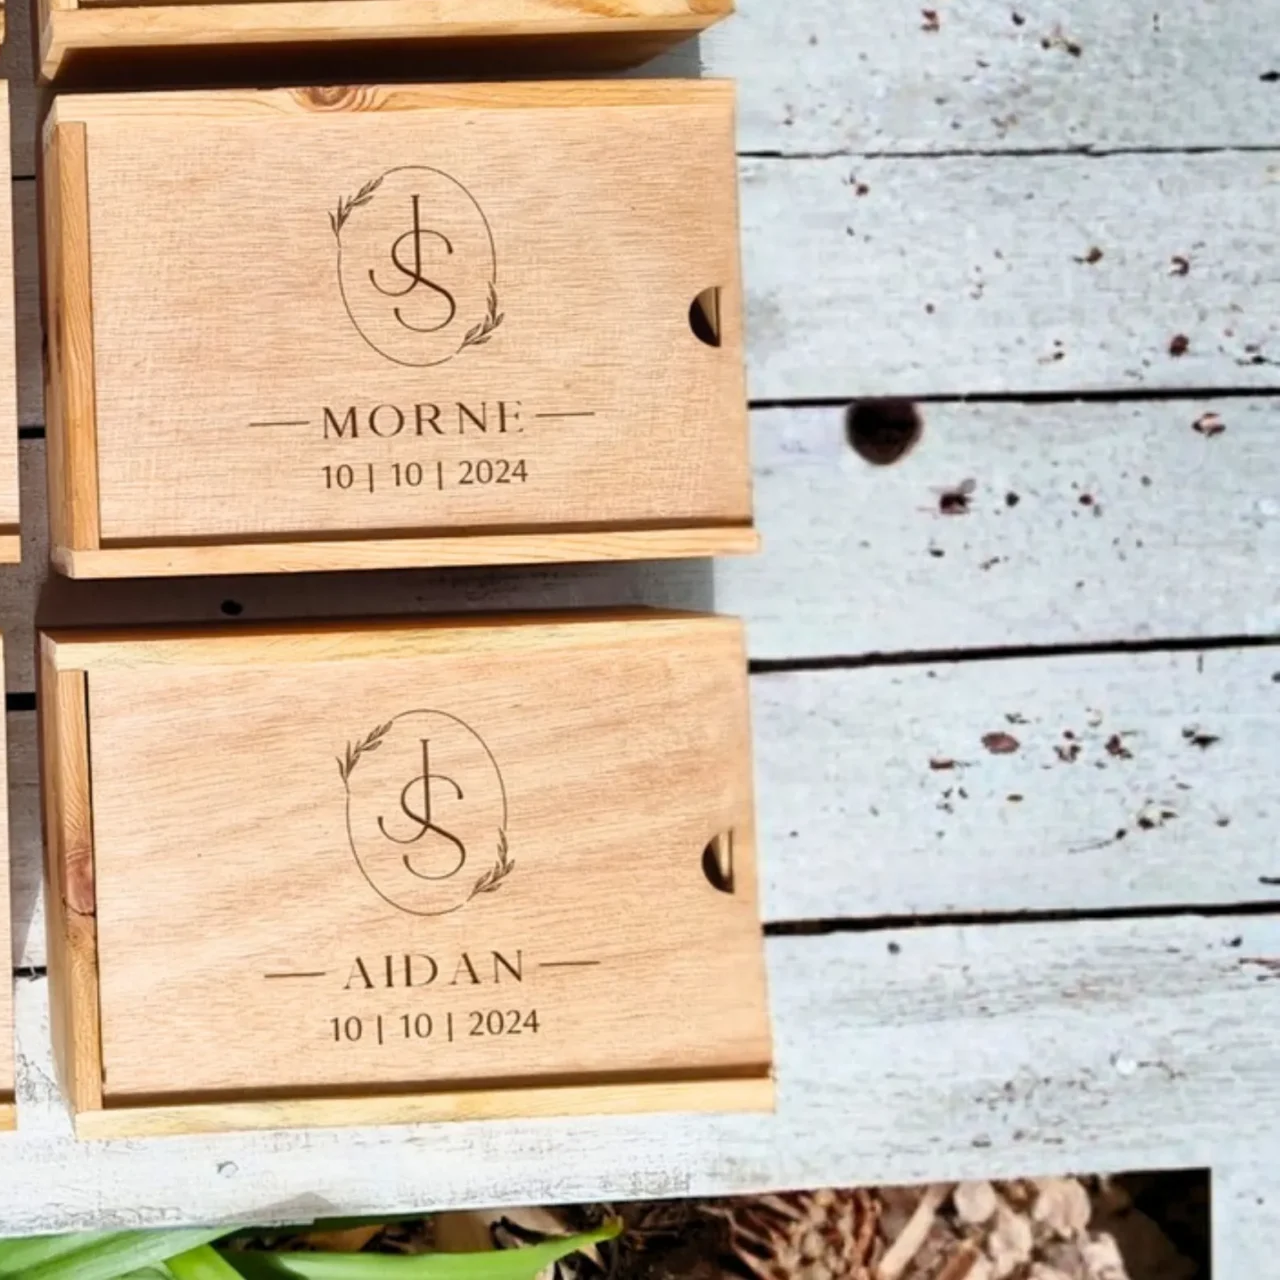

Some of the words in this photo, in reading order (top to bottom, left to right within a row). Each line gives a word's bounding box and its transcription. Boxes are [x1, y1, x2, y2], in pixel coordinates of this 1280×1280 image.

[321, 399, 525, 441] MORNE
[320, 463, 355, 490] 10
[390, 461, 424, 488] 10
[457, 458, 529, 486] 2024
[342, 948, 525, 991] AIDAN
[330, 1015, 363, 1043] 10
[399, 1012, 433, 1039] 10
[468, 1008, 541, 1037] 2024
